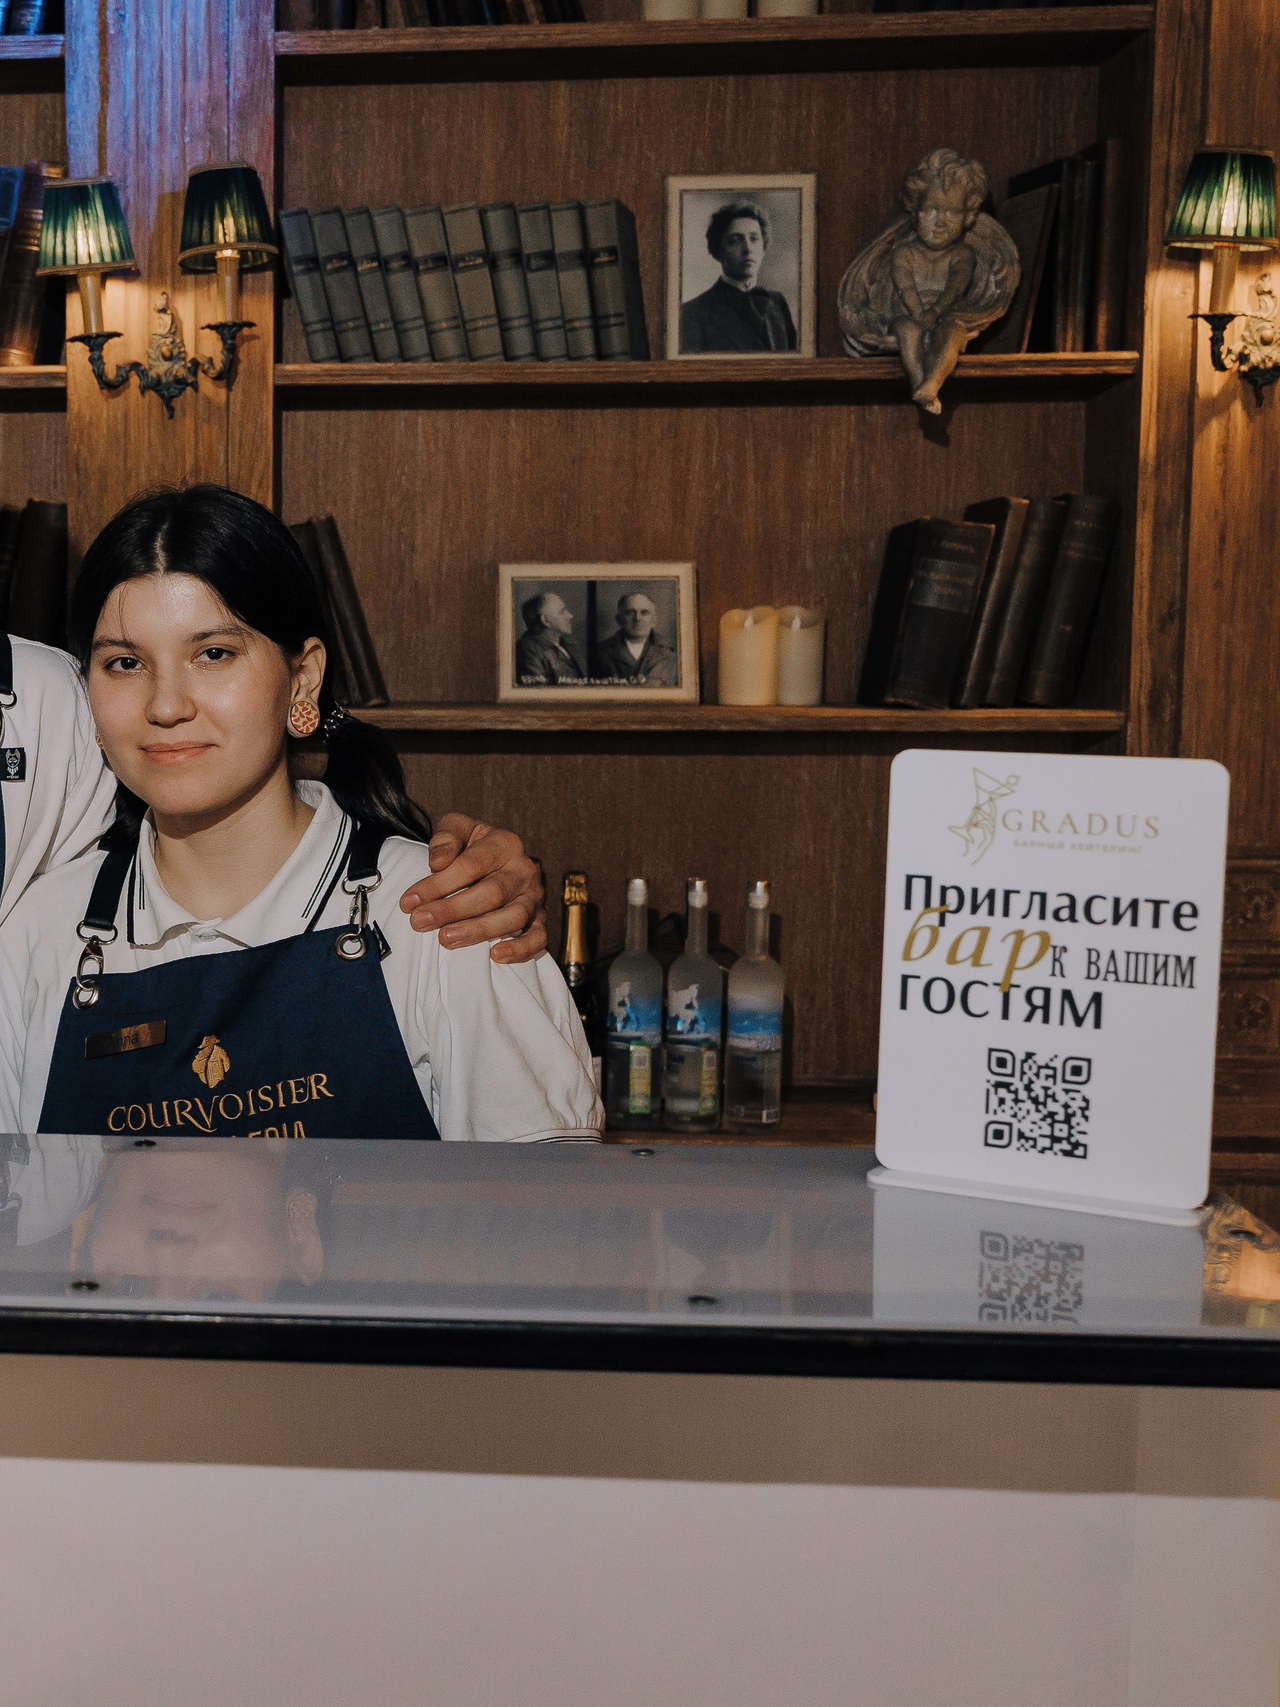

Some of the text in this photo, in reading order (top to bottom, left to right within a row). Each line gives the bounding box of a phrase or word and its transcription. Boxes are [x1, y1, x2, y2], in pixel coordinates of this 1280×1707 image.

[1001, 808, 1161, 840] GRADUS
[903, 873, 1199, 932] Пригласите
[901, 904, 1052, 994] бар
[1085, 947, 1197, 990] ВАШИМ
[107, 1073, 335, 1133] COURVOISIER
